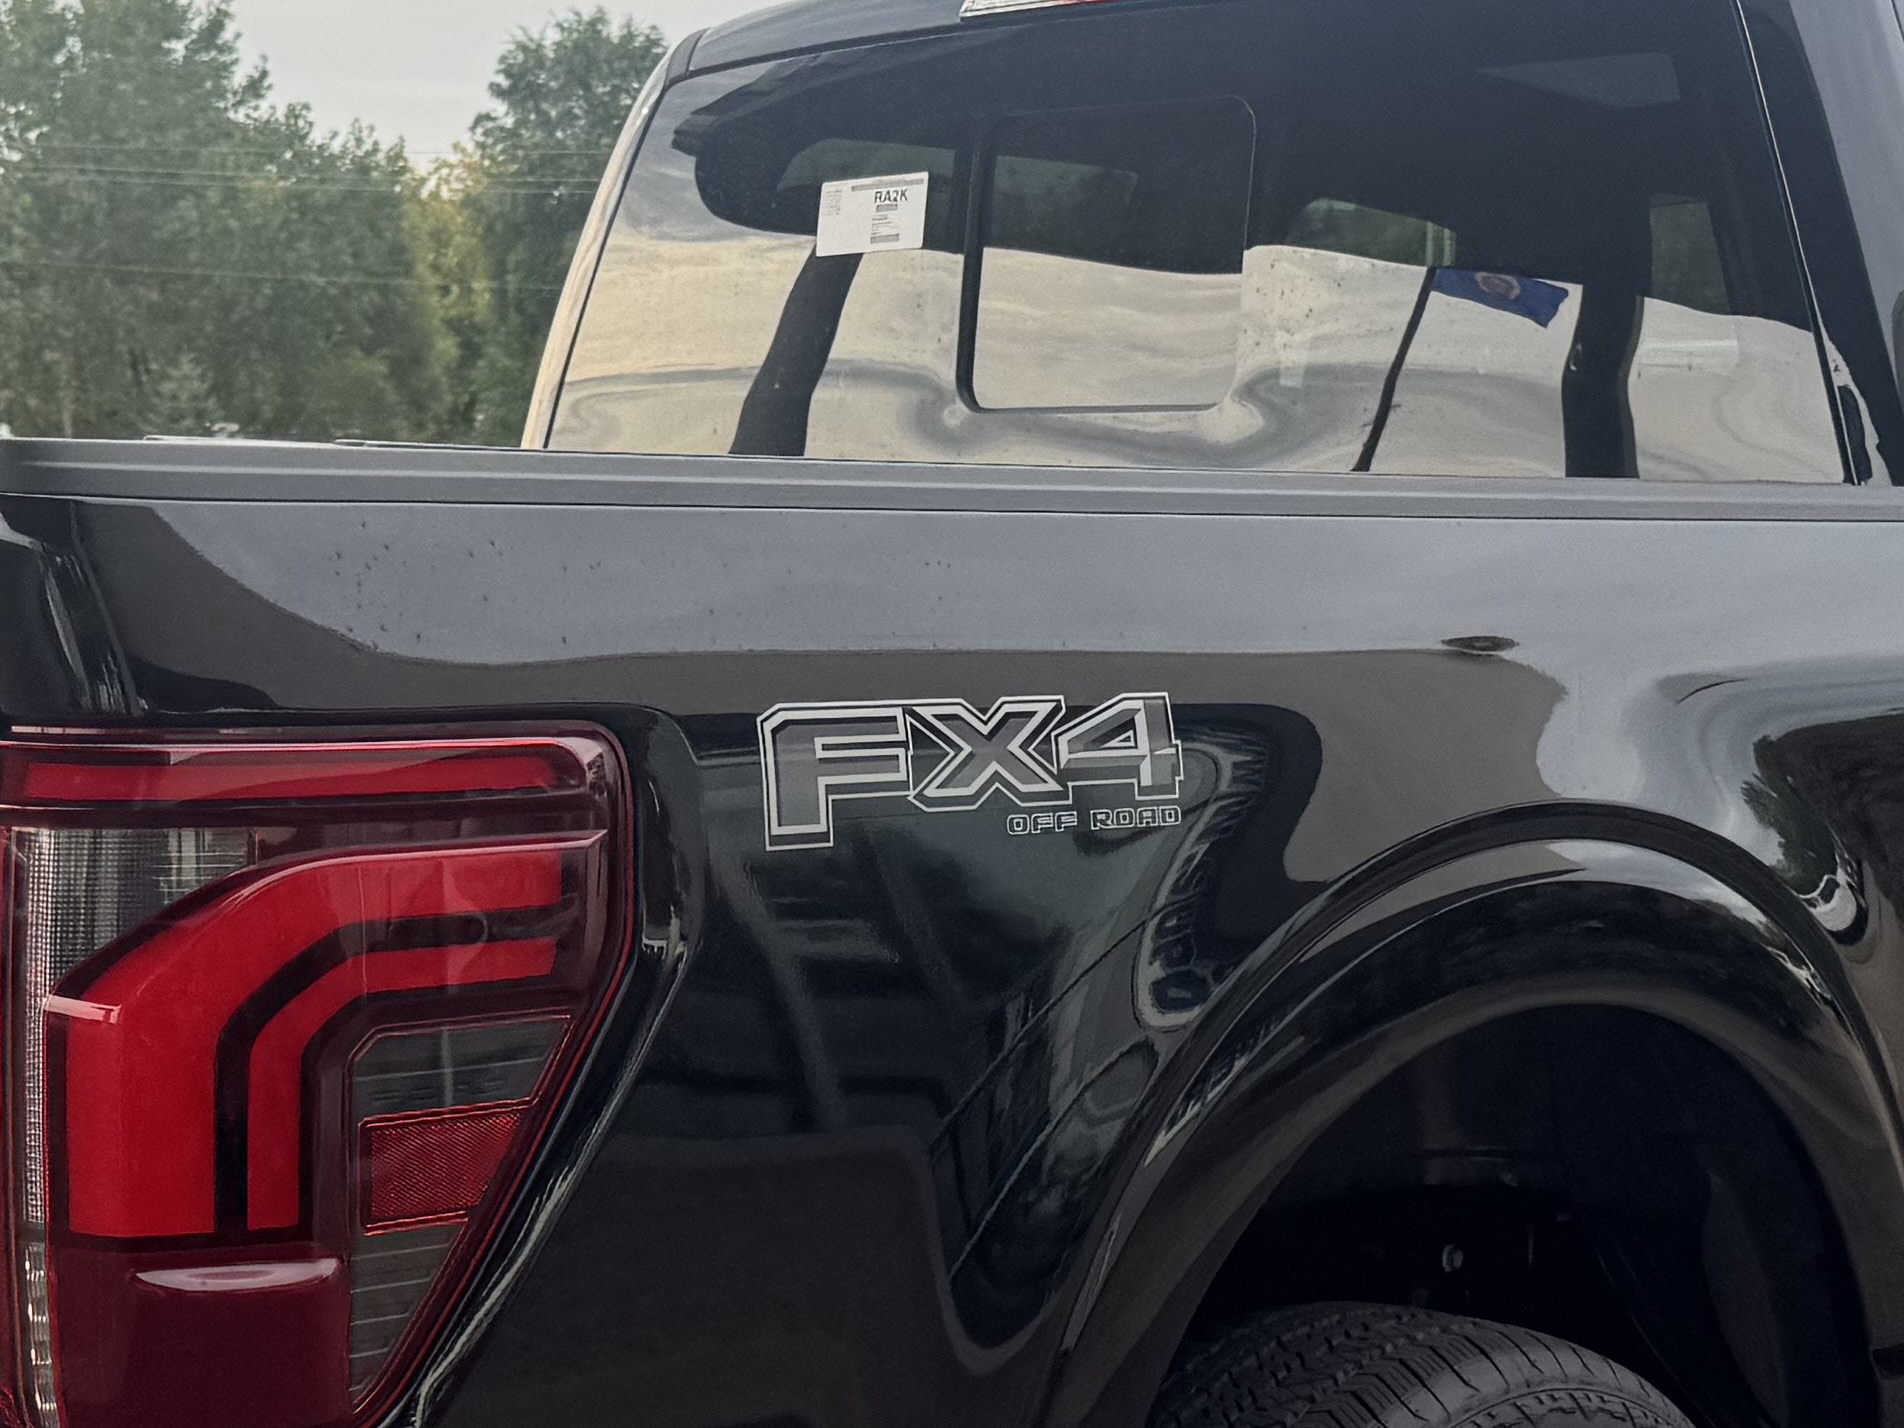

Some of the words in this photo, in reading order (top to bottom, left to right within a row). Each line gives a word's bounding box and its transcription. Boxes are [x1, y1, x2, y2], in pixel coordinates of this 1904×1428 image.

[756, 691, 1185, 852] FX4
[1006, 811, 1078, 835] OFF
[1089, 805, 1182, 832] ROAD
